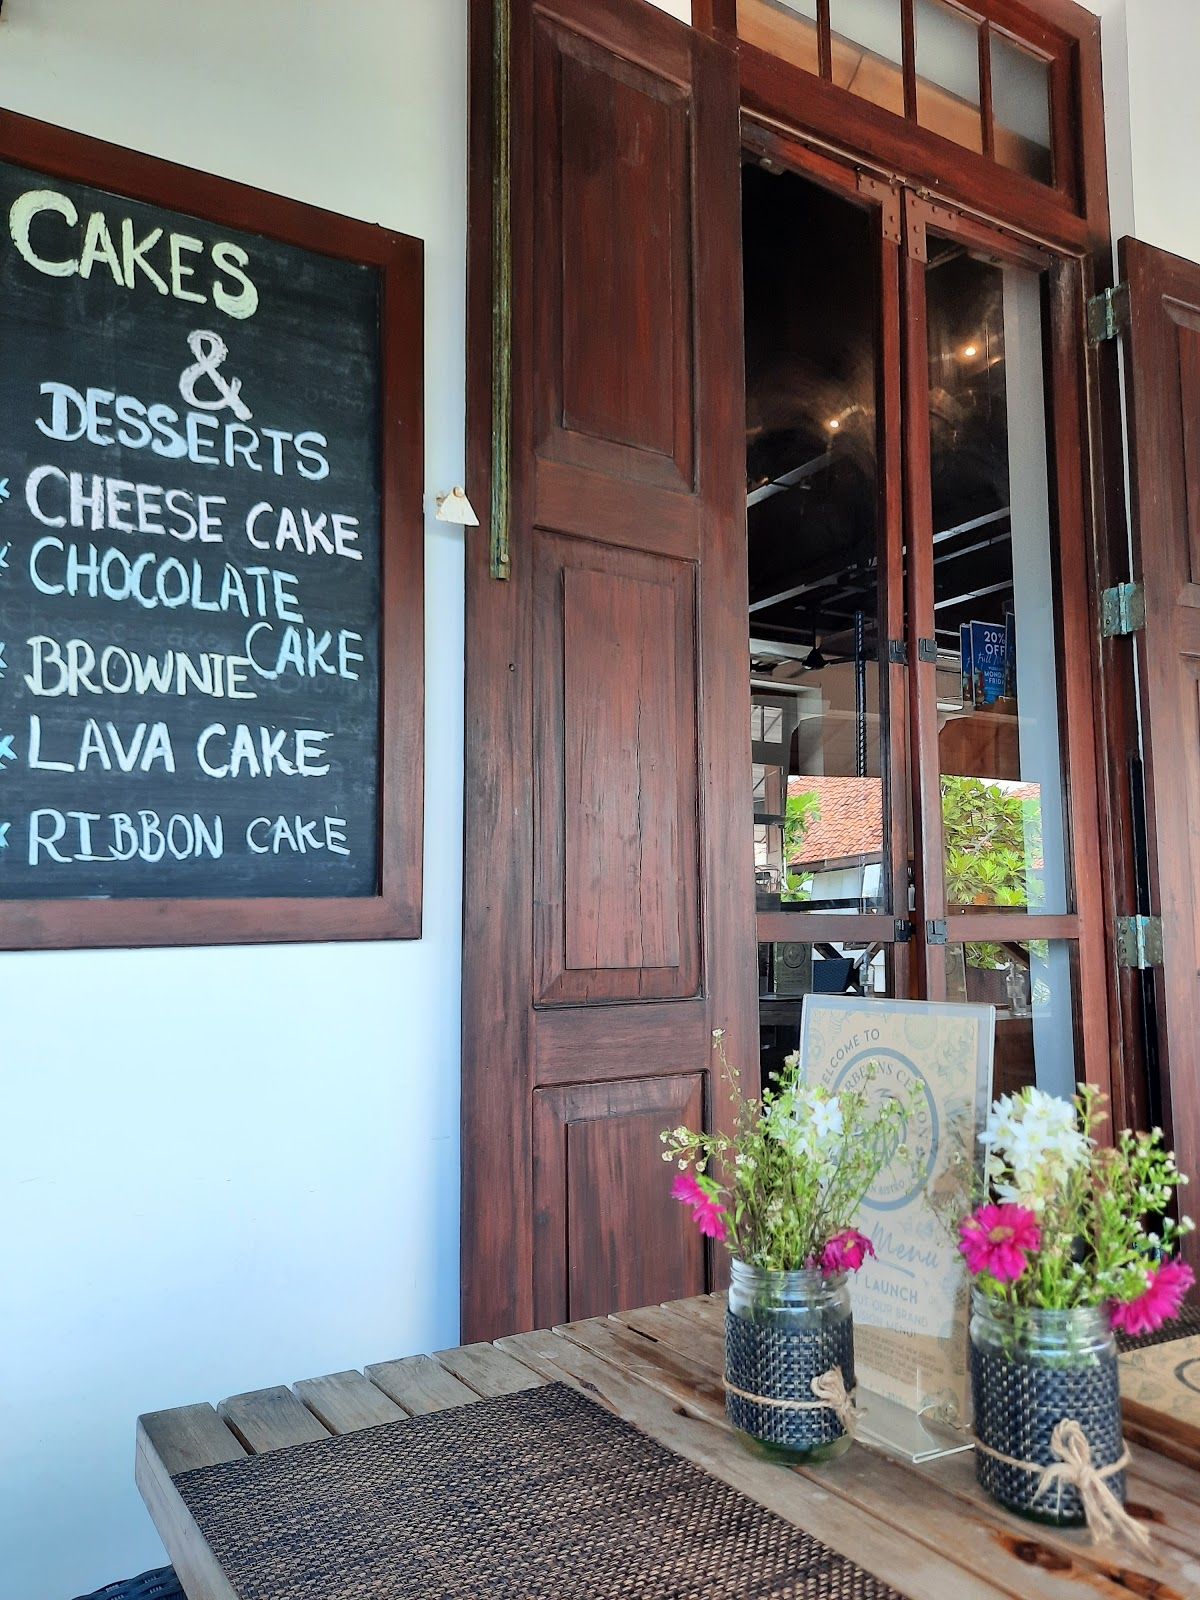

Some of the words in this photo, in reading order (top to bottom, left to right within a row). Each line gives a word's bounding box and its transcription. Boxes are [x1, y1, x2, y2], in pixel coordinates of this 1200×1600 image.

[8, 189, 259, 320] CAKES
[179, 329, 253, 421] &
[35, 381, 330, 481] DESSERTS
[25, 464, 228, 543] CHEESE
[245, 501, 363, 560] CAKE
[28, 536, 304, 623] CHOCOLATE
[24, 635, 257, 699] BROWNIE
[245, 621, 364, 681] CAKE
[985, 644, 1005, 656] OFF
[28, 714, 176, 773] LAVA
[197, 722, 334, 779] CAKE
[28, 807, 224, 866] RIBBON
[246, 814, 351, 857] CAKE
[820, 1036, 860, 1086] ELCOME
[863, 1028, 880, 1042] TO
[871, 1221, 939, 1268] Menu
[865, 1273, 919, 1304] LAUNCH
